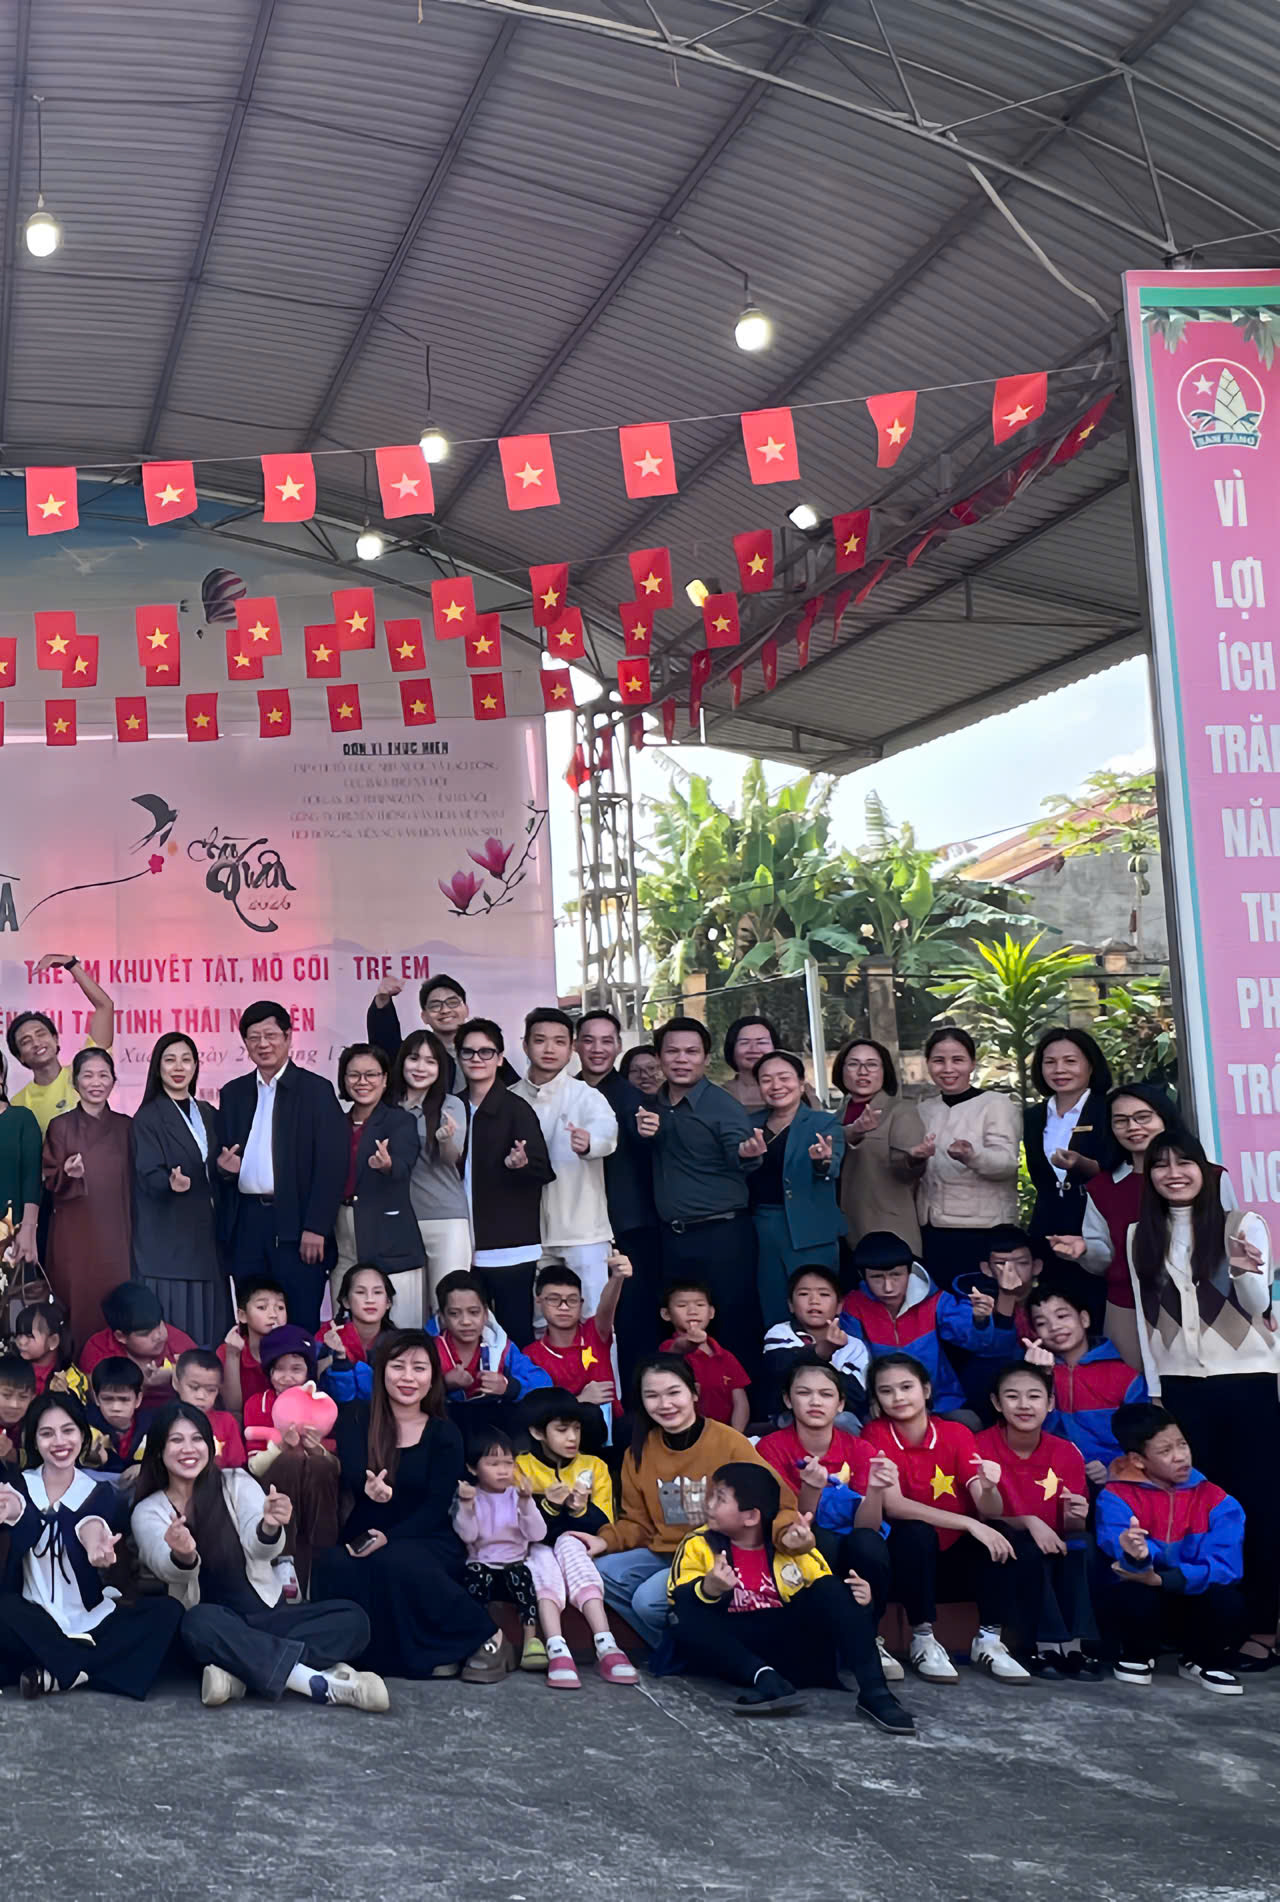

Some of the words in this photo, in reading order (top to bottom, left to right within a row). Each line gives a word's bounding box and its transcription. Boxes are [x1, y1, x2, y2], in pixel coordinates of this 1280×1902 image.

[1214, 469, 1248, 527] VÌ
[1212, 556, 1266, 620] LỢI
[1218, 631, 1276, 691] ÍCH
[1241, 891, 1280, 942] TH
[401, 955, 431, 981] EM
[1236, 977, 1280, 1029] PH
